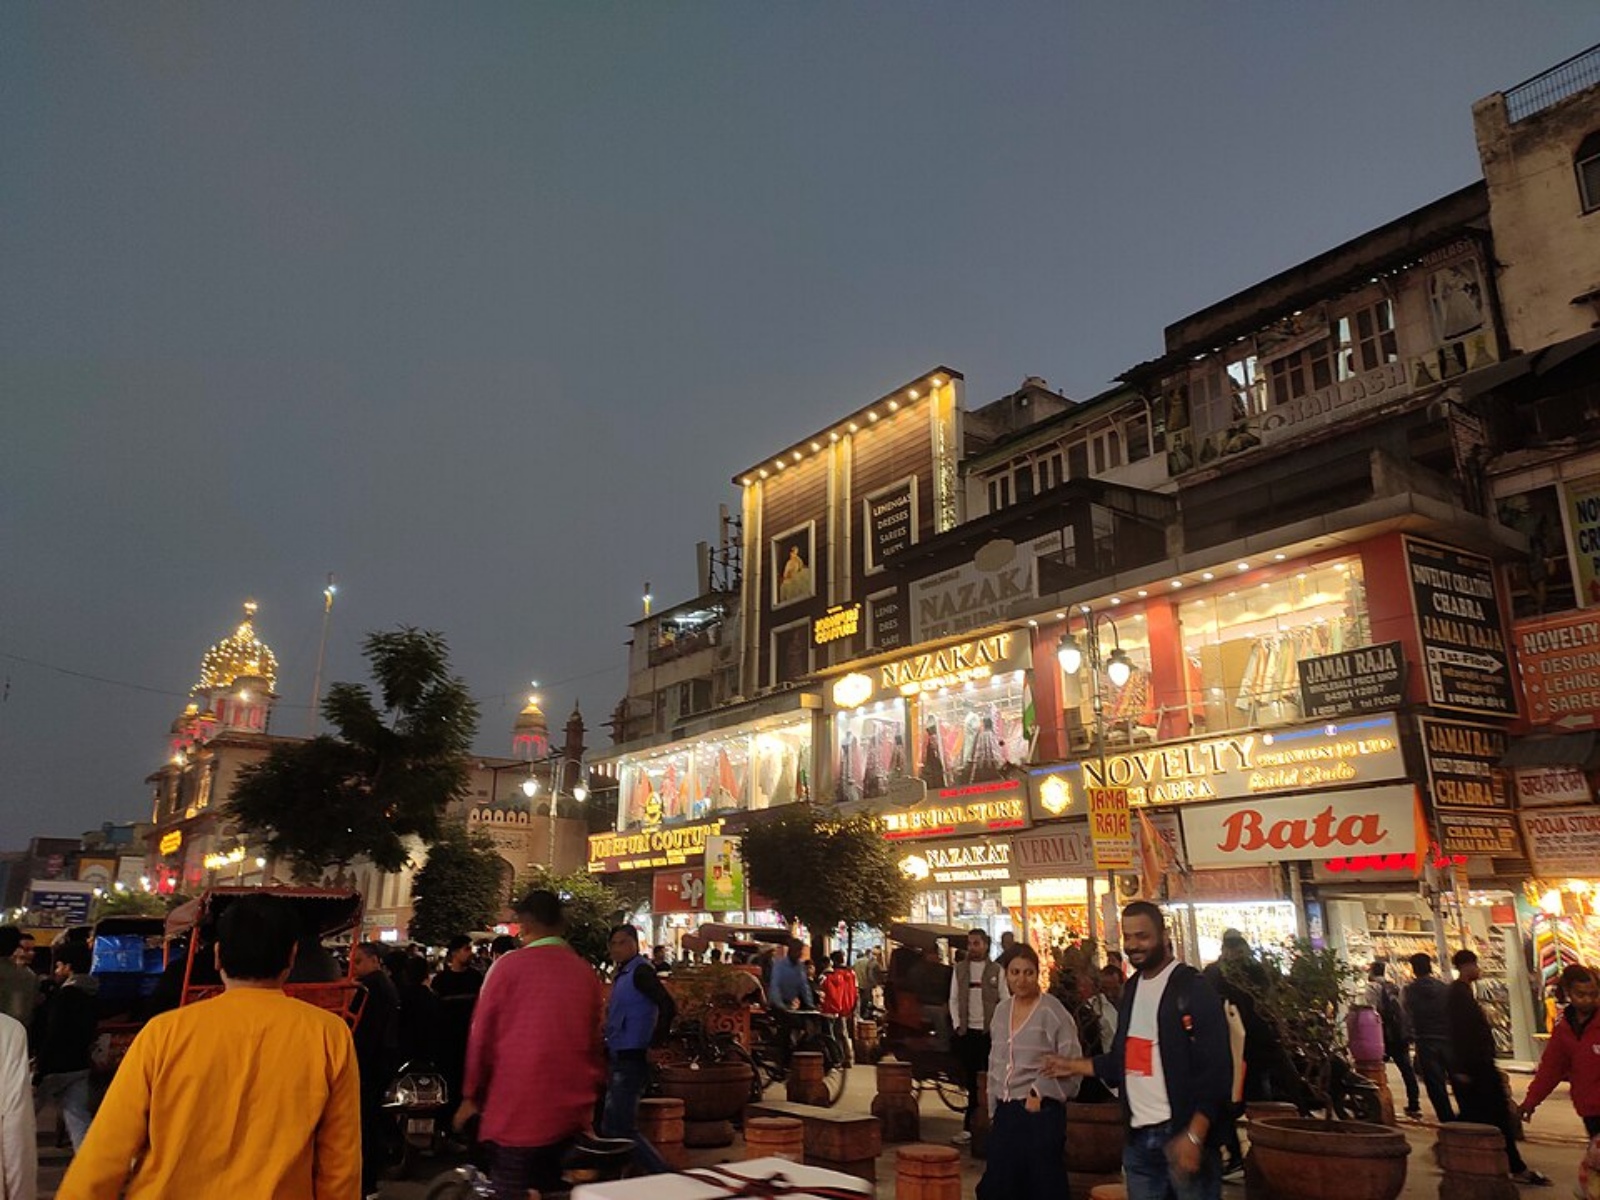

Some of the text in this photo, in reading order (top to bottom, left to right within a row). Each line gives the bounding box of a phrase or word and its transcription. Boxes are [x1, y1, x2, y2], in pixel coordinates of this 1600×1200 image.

[878, 510, 908, 530] DRESSES
[1432, 592, 1485, 621] CHABRA
[1423, 615, 1504, 653] JAMAI RAJA
[1523, 623, 1599, 655] NOVELTY
[880, 634, 1011, 687] NAZAKAT
[1306, 647, 1397, 684] JAMAI RAJA
[1430, 726, 1473, 754] JAMAI
[1081, 735, 1256, 789] NOVELTY
[1302, 761, 1358, 784] Studio
[1089, 789, 1128, 812] JAMAI
[1436, 779, 1494, 805] CHABRA
[967, 799, 1023, 820] STORE
[1095, 813, 1128, 837] RAJA
[1217, 805, 1388, 852] Bata
[1526, 818, 1569, 834] POOJA
[925, 844, 1010, 868] NAZAKAT
[1019, 836, 1078, 864] VERMA
